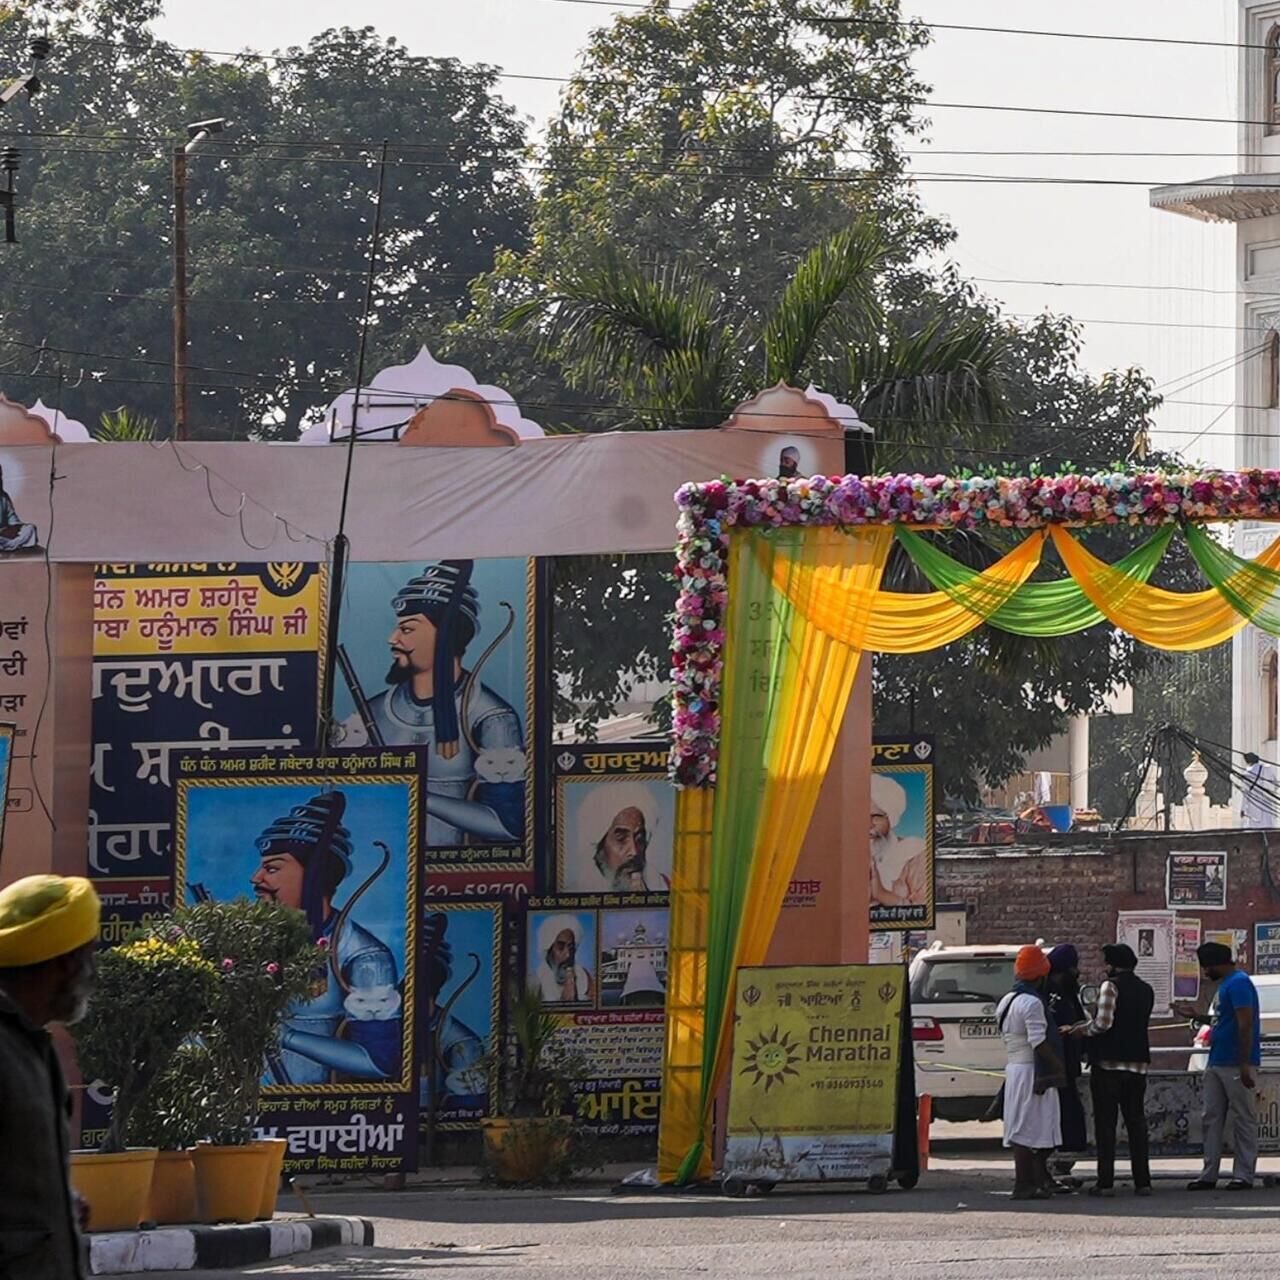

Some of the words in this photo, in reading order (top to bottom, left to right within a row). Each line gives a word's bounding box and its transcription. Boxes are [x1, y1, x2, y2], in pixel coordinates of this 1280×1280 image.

[135, 588, 191, 608] ਅਮਰ
[200, 579, 258, 609] ਸ਼ਹੀਦ
[94, 619, 129, 639] ਾਬਾ
[138, 611, 218, 650] ਹਨੂੰਮਾਨ
[228, 608, 273, 636] ਸਿੰਘ
[283, 607, 307, 635] ਜੀ
[582, 752, 670, 773] ਗੁਰਦੁਆ
[809, 1024, 891, 1043] Chennai
[806, 1044, 891, 1062] Maratha
[287, 1114, 404, 1153] ਵਧਾਈਆਂ
